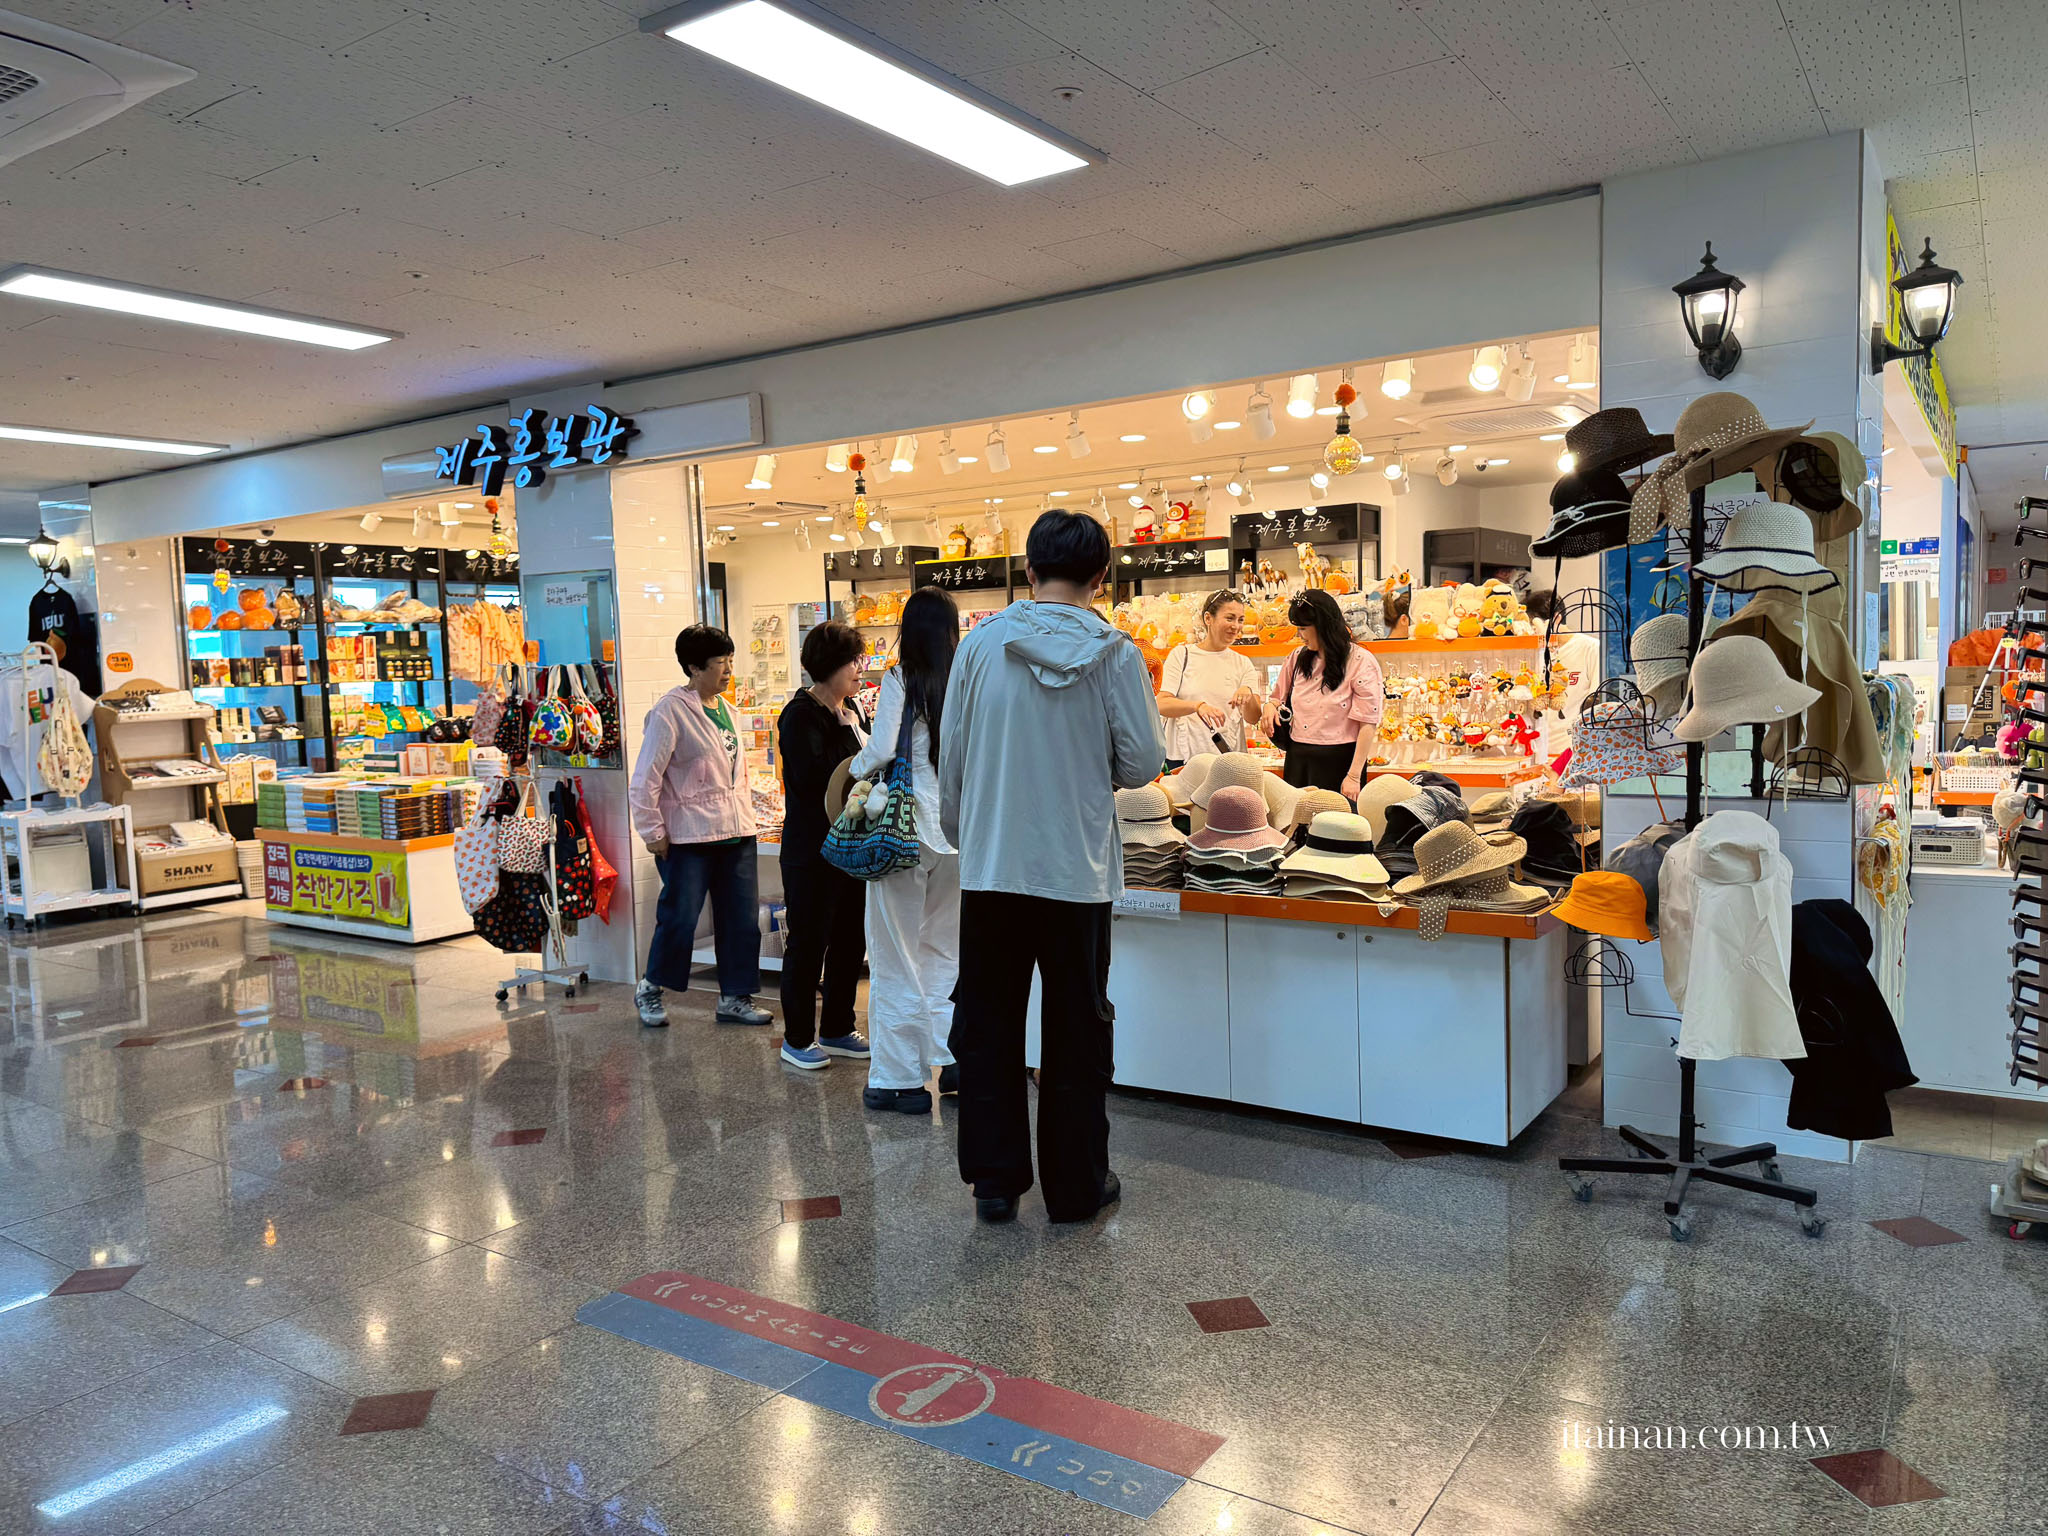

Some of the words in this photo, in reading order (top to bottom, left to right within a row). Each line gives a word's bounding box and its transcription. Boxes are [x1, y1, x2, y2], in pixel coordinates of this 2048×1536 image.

[435, 404, 626, 497] 제주홍보관
[1255, 515, 1332, 540] 제주홍보관
[932, 565, 987, 586] 제주홍보관
[267, 845, 288, 863] 전국
[164, 864, 214, 877] SHANY
[267, 866, 290, 882] 택배
[269, 884, 290, 903] 가능
[690, 1292, 872, 1355] SUBMARINE
